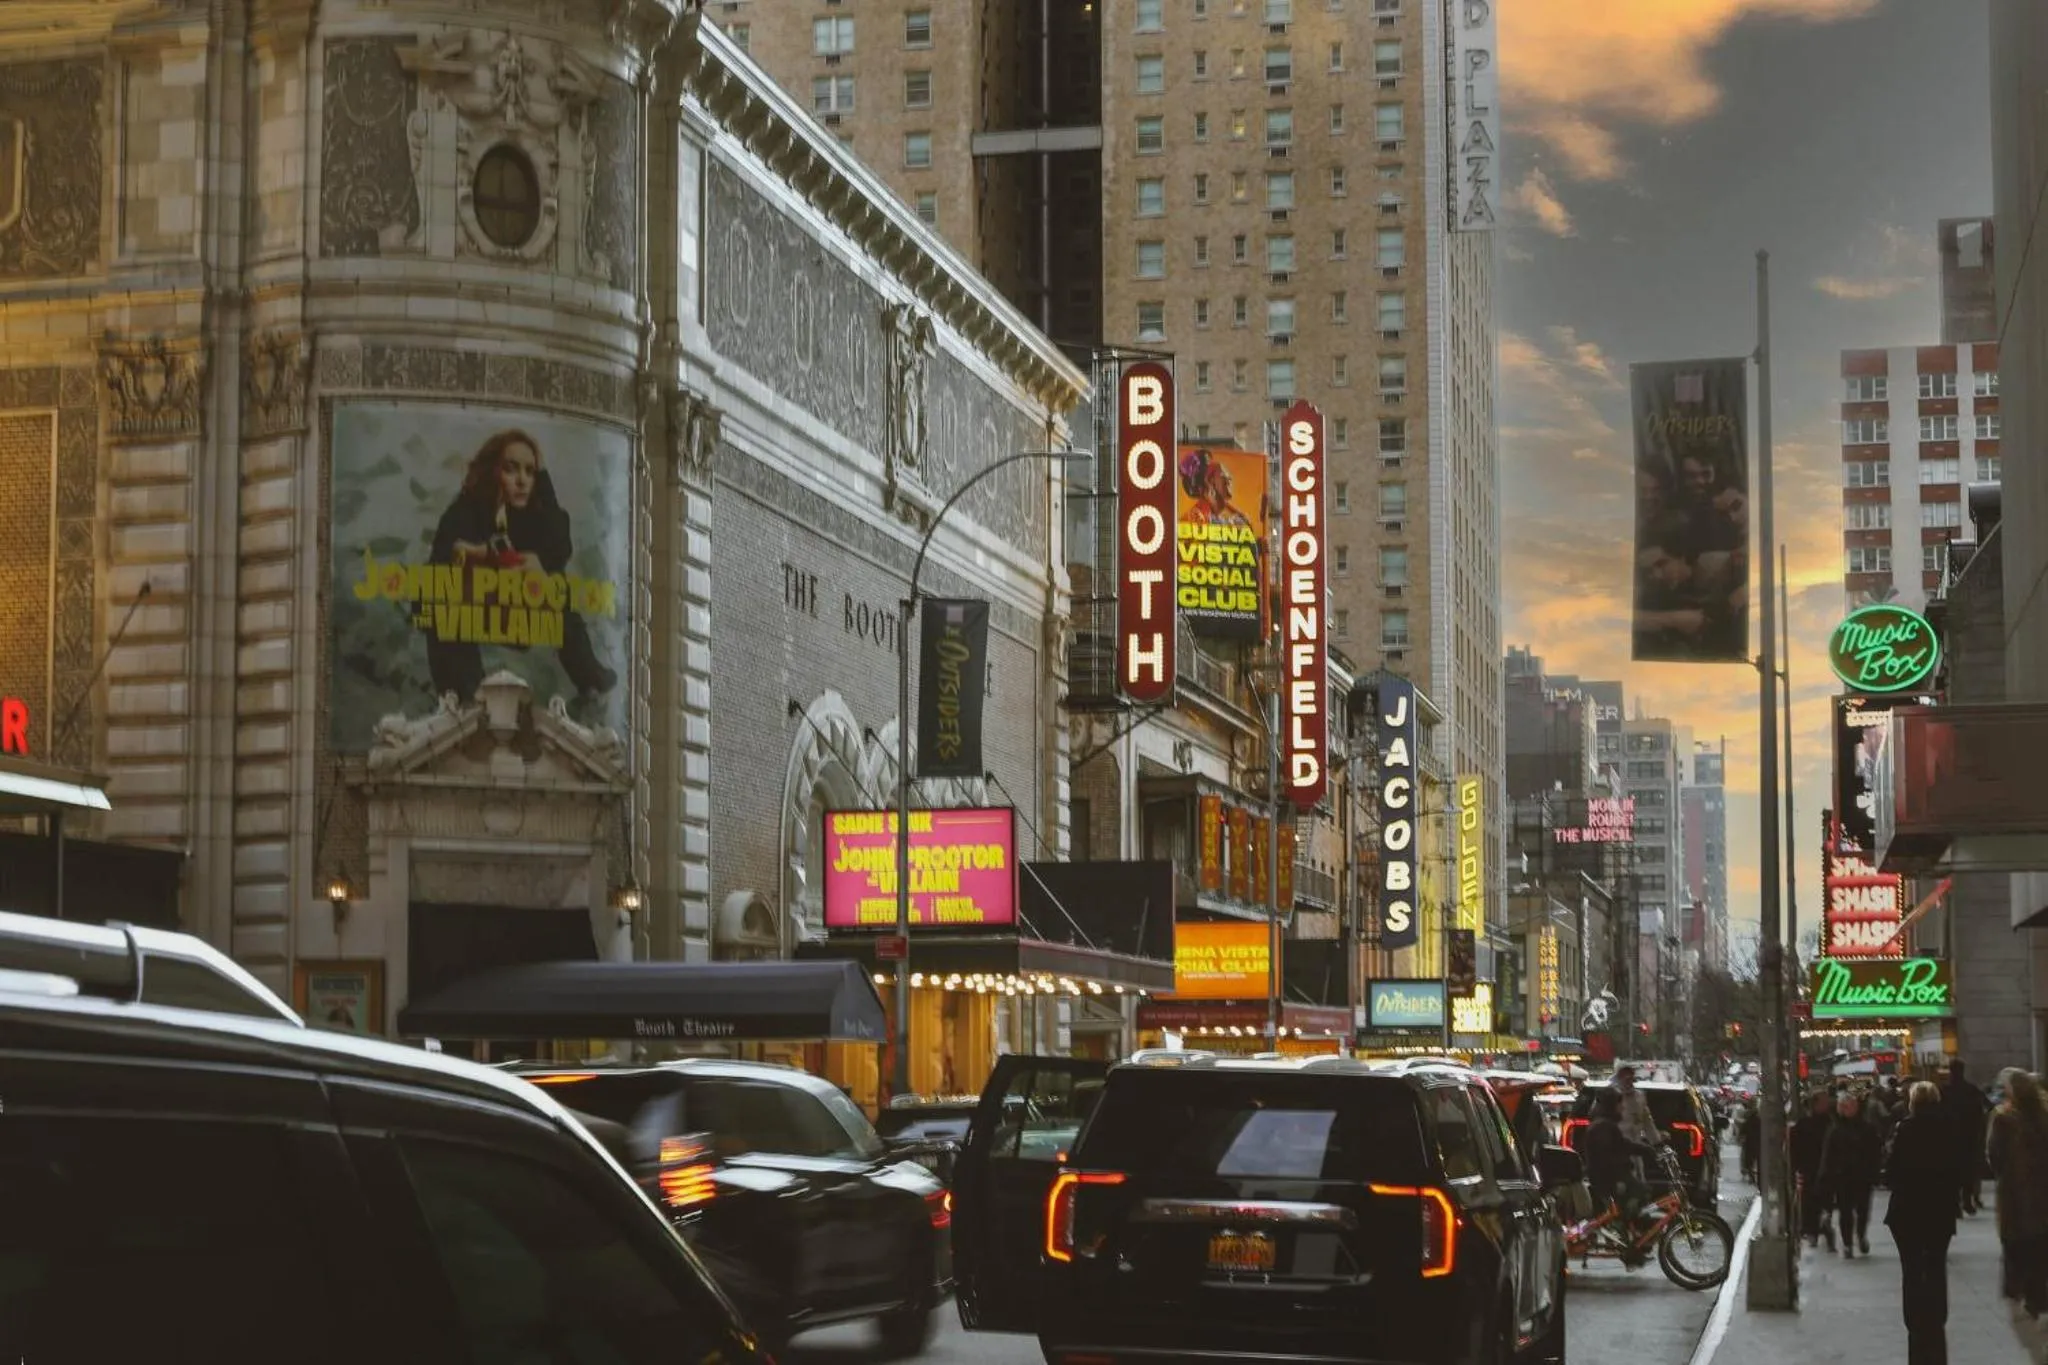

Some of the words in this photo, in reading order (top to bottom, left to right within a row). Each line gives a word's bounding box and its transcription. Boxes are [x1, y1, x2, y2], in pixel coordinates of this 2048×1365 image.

[1460, 48, 1495, 225] PLAZA
[1127, 375, 1165, 684] BOOTH
[1177, 523, 1257, 545] BUENA
[1178, 545, 1257, 568] VISTA
[353, 546, 464, 604] JOHN
[473, 565, 616, 621] PROCTOR
[782, 562, 819, 619] THE
[1177, 567, 1257, 588] SOCIAL
[1178, 590, 1258, 611] CLUB
[1288, 421, 1319, 787] SCHOENFELD
[434, 604, 564, 649] VILLAIN
[1838, 615, 1920, 655] Music
[1855, 646, 1926, 682] Box
[833, 813, 884, 835] SADIE
[1383, 695, 1412, 933] JACOBS
[1554, 828, 1581, 843] THE
[833, 839, 897, 872] JOHN
[1460, 779, 1479, 931] GOLDEN
[1831, 886, 1896, 914] SMASH
[1816, 958, 1897, 1004] Music
[1896, 957, 1947, 1004] Box
[633, 1017, 676, 1037] Booth
[682, 1017, 736, 1037] Theatre
